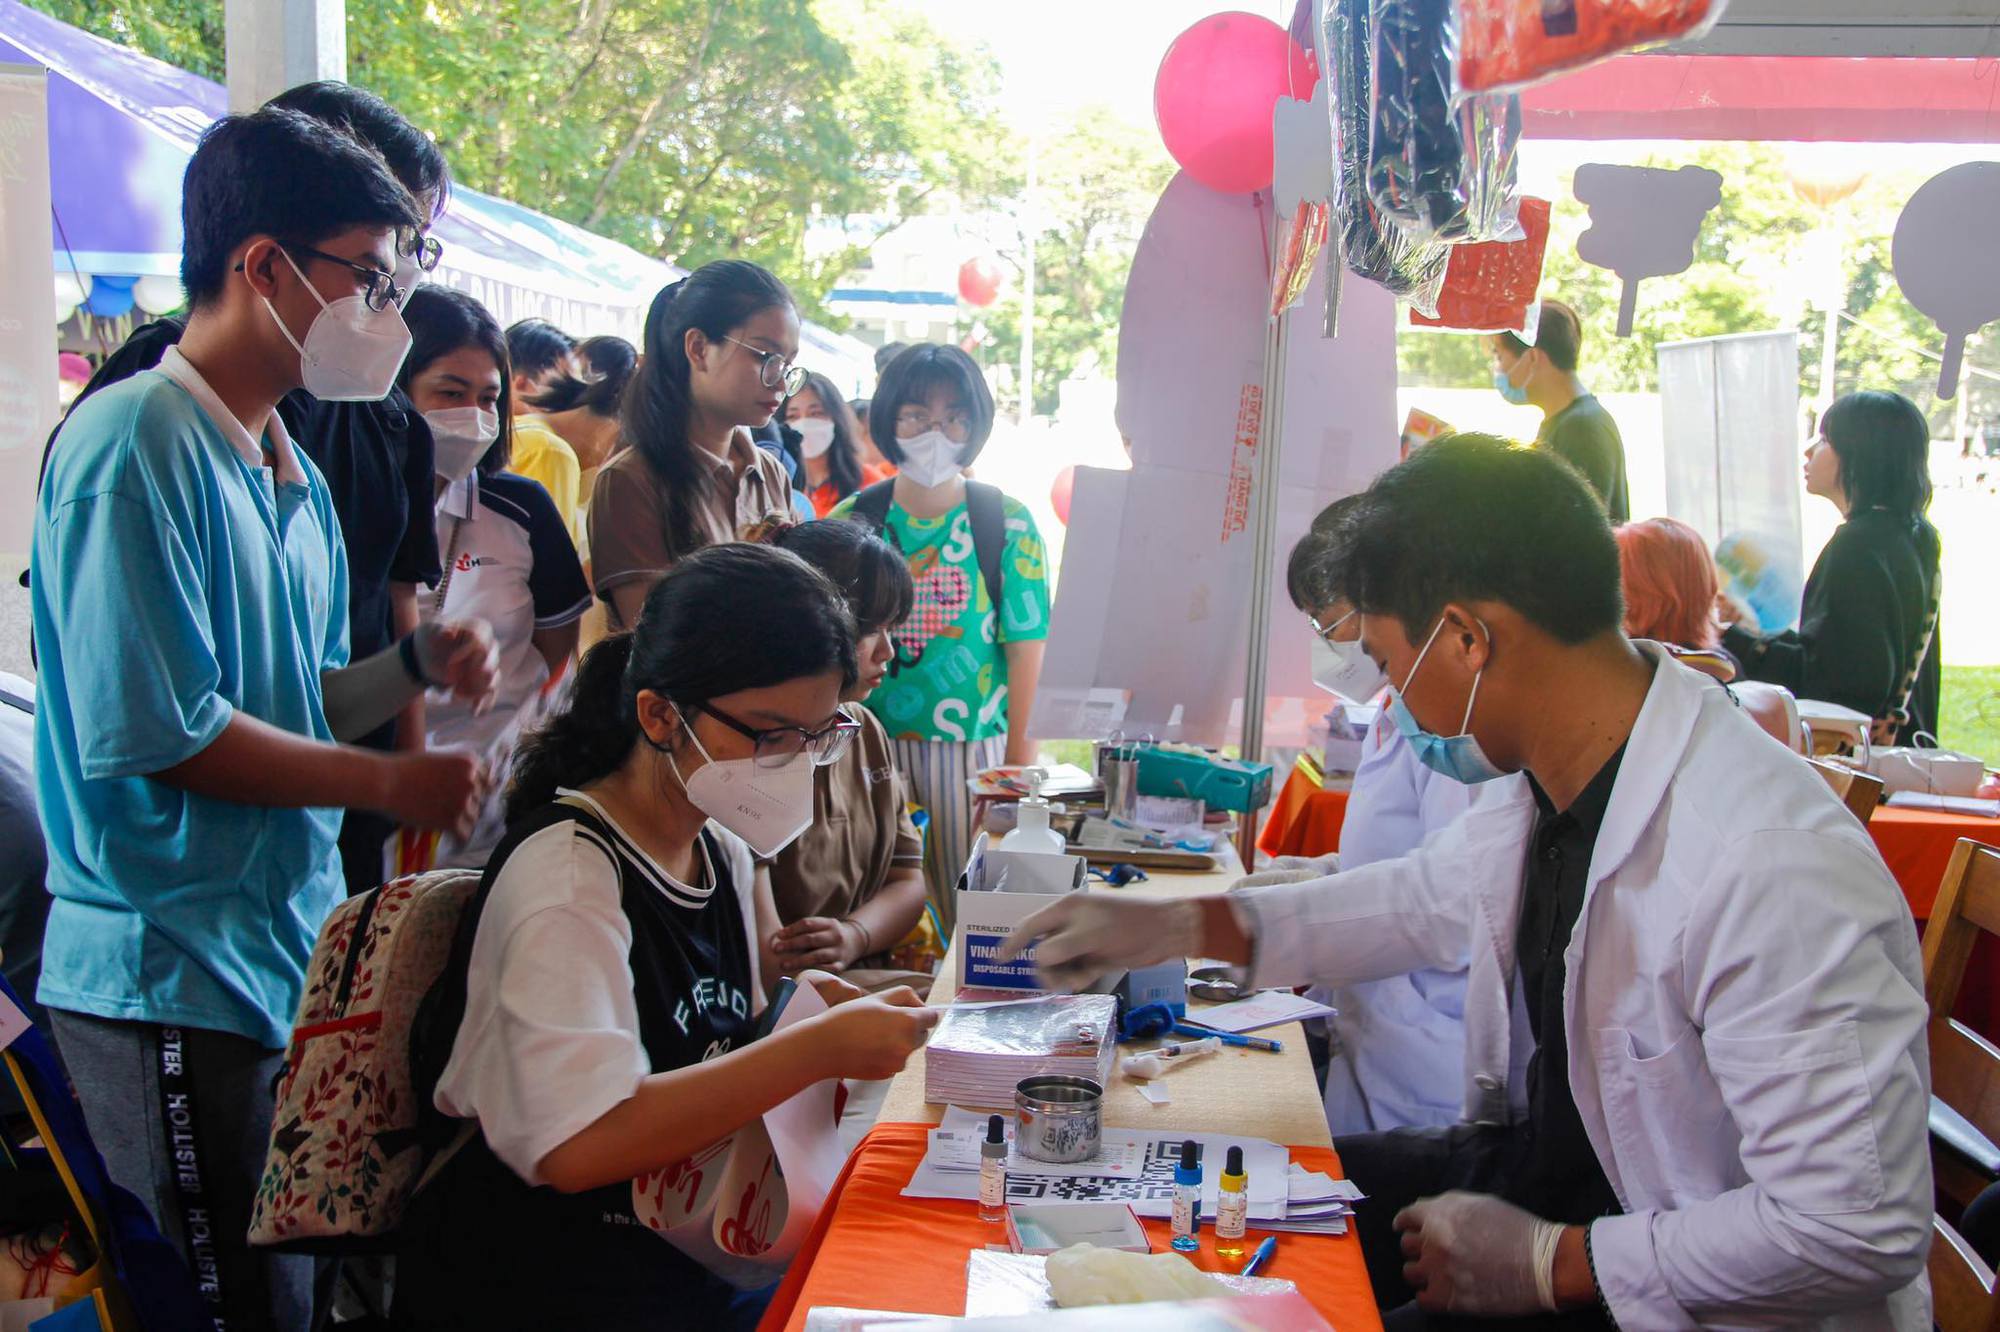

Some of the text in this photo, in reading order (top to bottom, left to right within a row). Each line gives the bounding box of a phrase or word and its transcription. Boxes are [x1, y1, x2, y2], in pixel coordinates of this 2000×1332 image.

[966, 924, 1010, 933] STERILIZED
[973, 964, 1016, 975] DISPOSABLE
[167, 1093, 203, 1194] HOLLISTER
